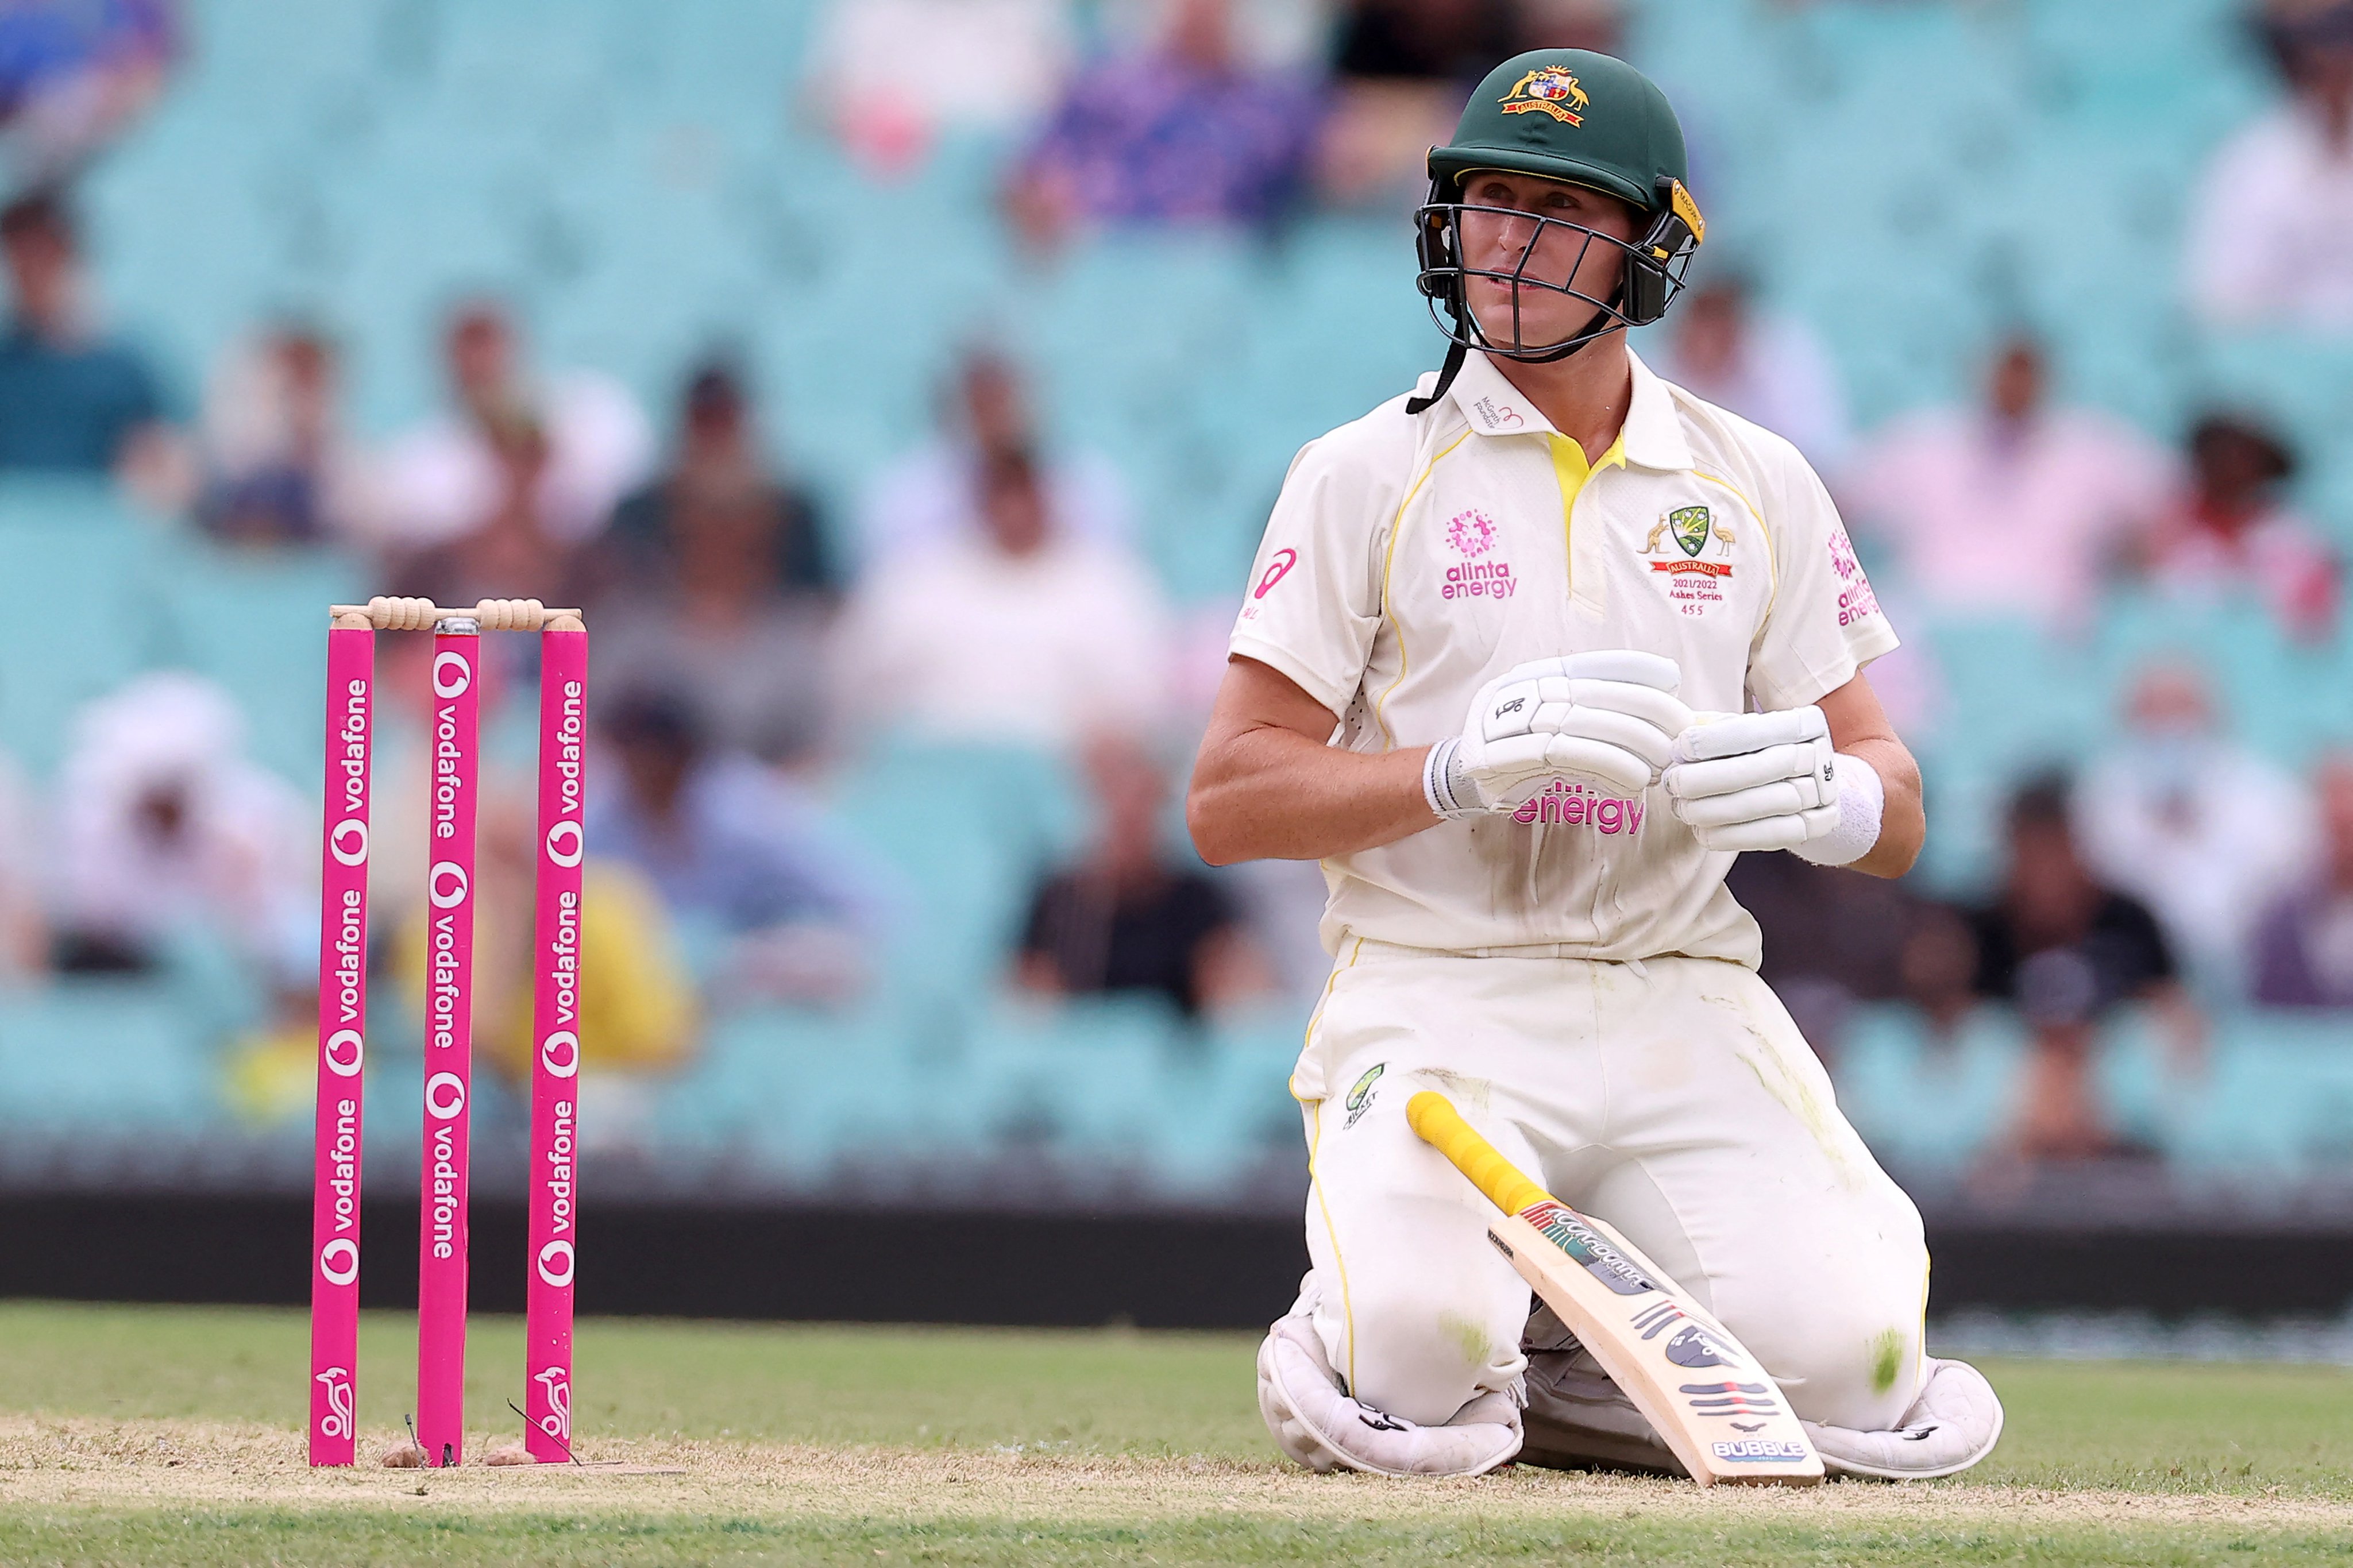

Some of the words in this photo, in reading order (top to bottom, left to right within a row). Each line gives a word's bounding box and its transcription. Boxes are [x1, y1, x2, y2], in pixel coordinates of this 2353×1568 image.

[1519, 101, 1564, 119] AUSTRALIA
[1473, 401, 1495, 429] Foundati
[1482, 396, 1501, 424] McGrath
[1446, 561, 1510, 581] alinta
[1671, 562, 1716, 576] AUSTRALIA
[1673, 578, 1717, 589] 2021/2022
[1442, 578, 1517, 599] energy
[1669, 590, 1695, 600] Ashes
[1697, 590, 1723, 601] Series
[1838, 578, 1870, 608] alinta
[1838, 594, 1880, 627] energ
[341, 679, 366, 813] vodafone
[556, 681, 581, 814] vodafone
[437, 705, 462, 839] vodafone
[1512, 796, 1645, 835] energy
[335, 890, 361, 1024] vodafone
[551, 891, 577, 1025] vodafone
[434, 915, 460, 1049] vodafone
[330, 1099, 356, 1232] vodafone
[547, 1101, 573, 1234] vodafone
[434, 1125, 458, 1259] vodafone
[1712, 1440, 1807, 1459] BUBBLE
